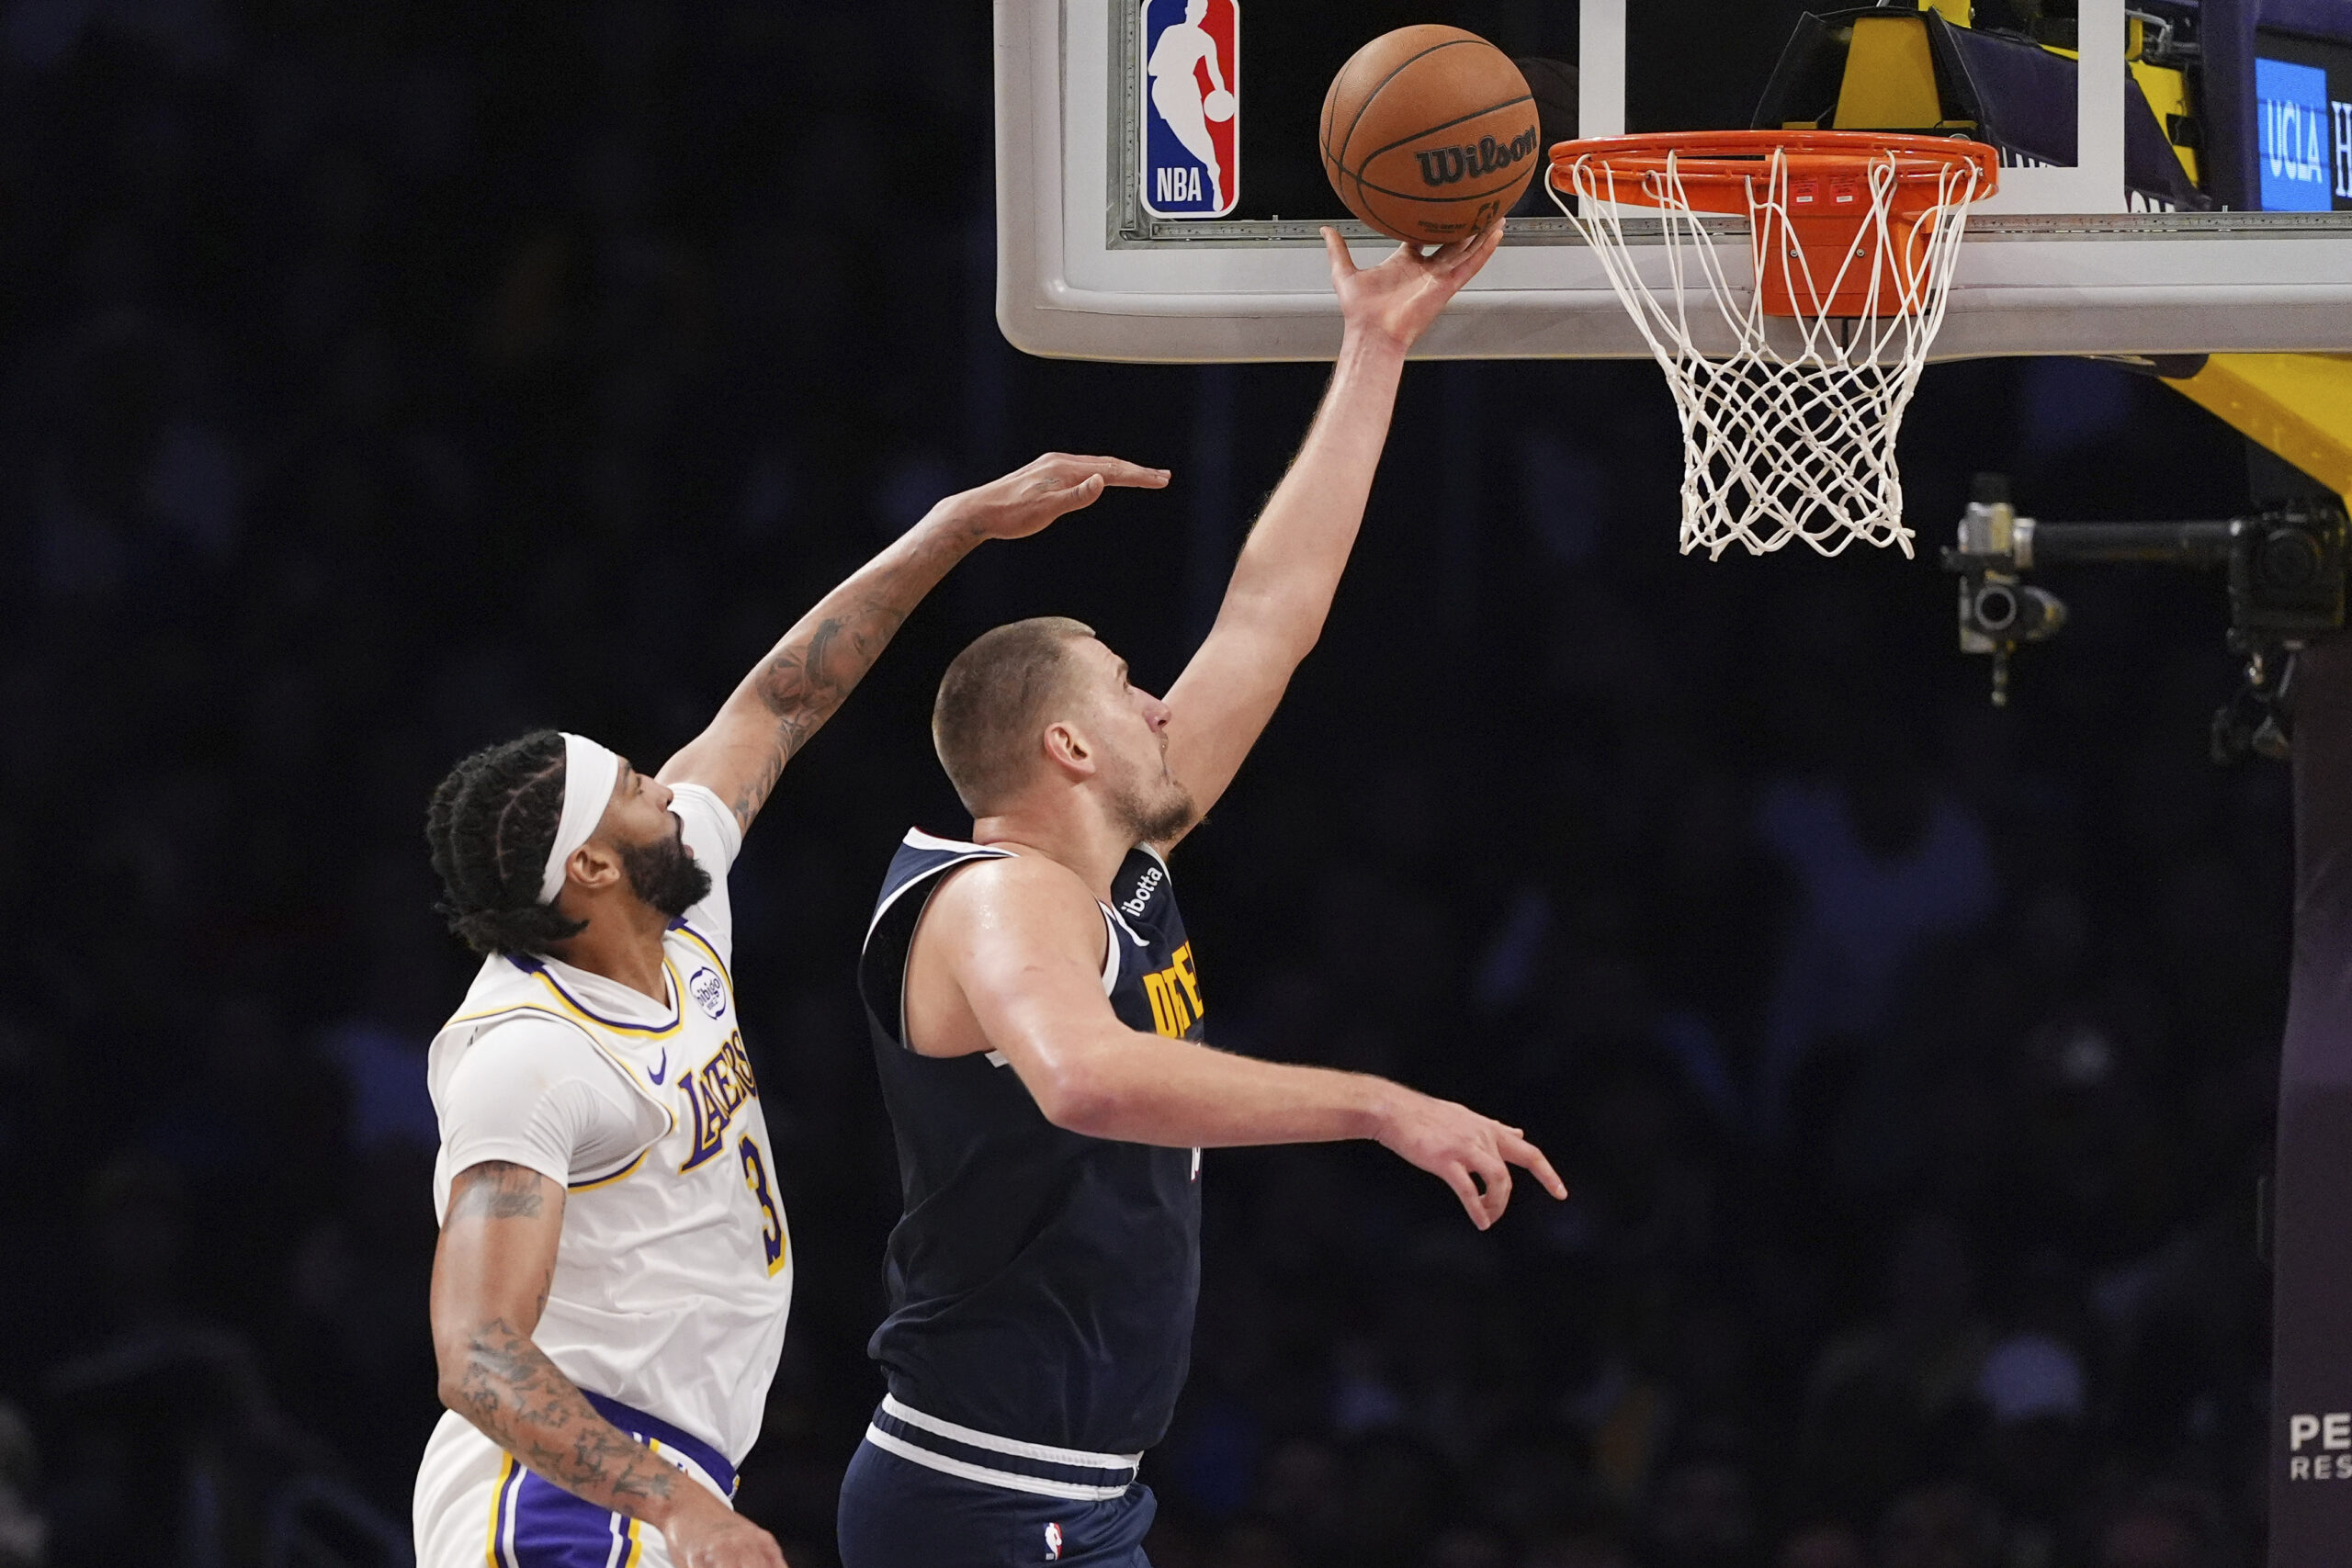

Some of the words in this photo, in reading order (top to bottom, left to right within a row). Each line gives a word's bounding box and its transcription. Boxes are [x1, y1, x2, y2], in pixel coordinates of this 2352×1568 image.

[1415, 125, 1537, 186] Wilson
[2267, 98, 2323, 184] UCLA
[1157, 167, 1203, 202] NBA
[1121, 867, 1163, 917] ibotta
[739, 1133, 787, 1279] 3
[2290, 1412, 2352, 1451] PE
[2290, 1454, 2352, 1482] RES
